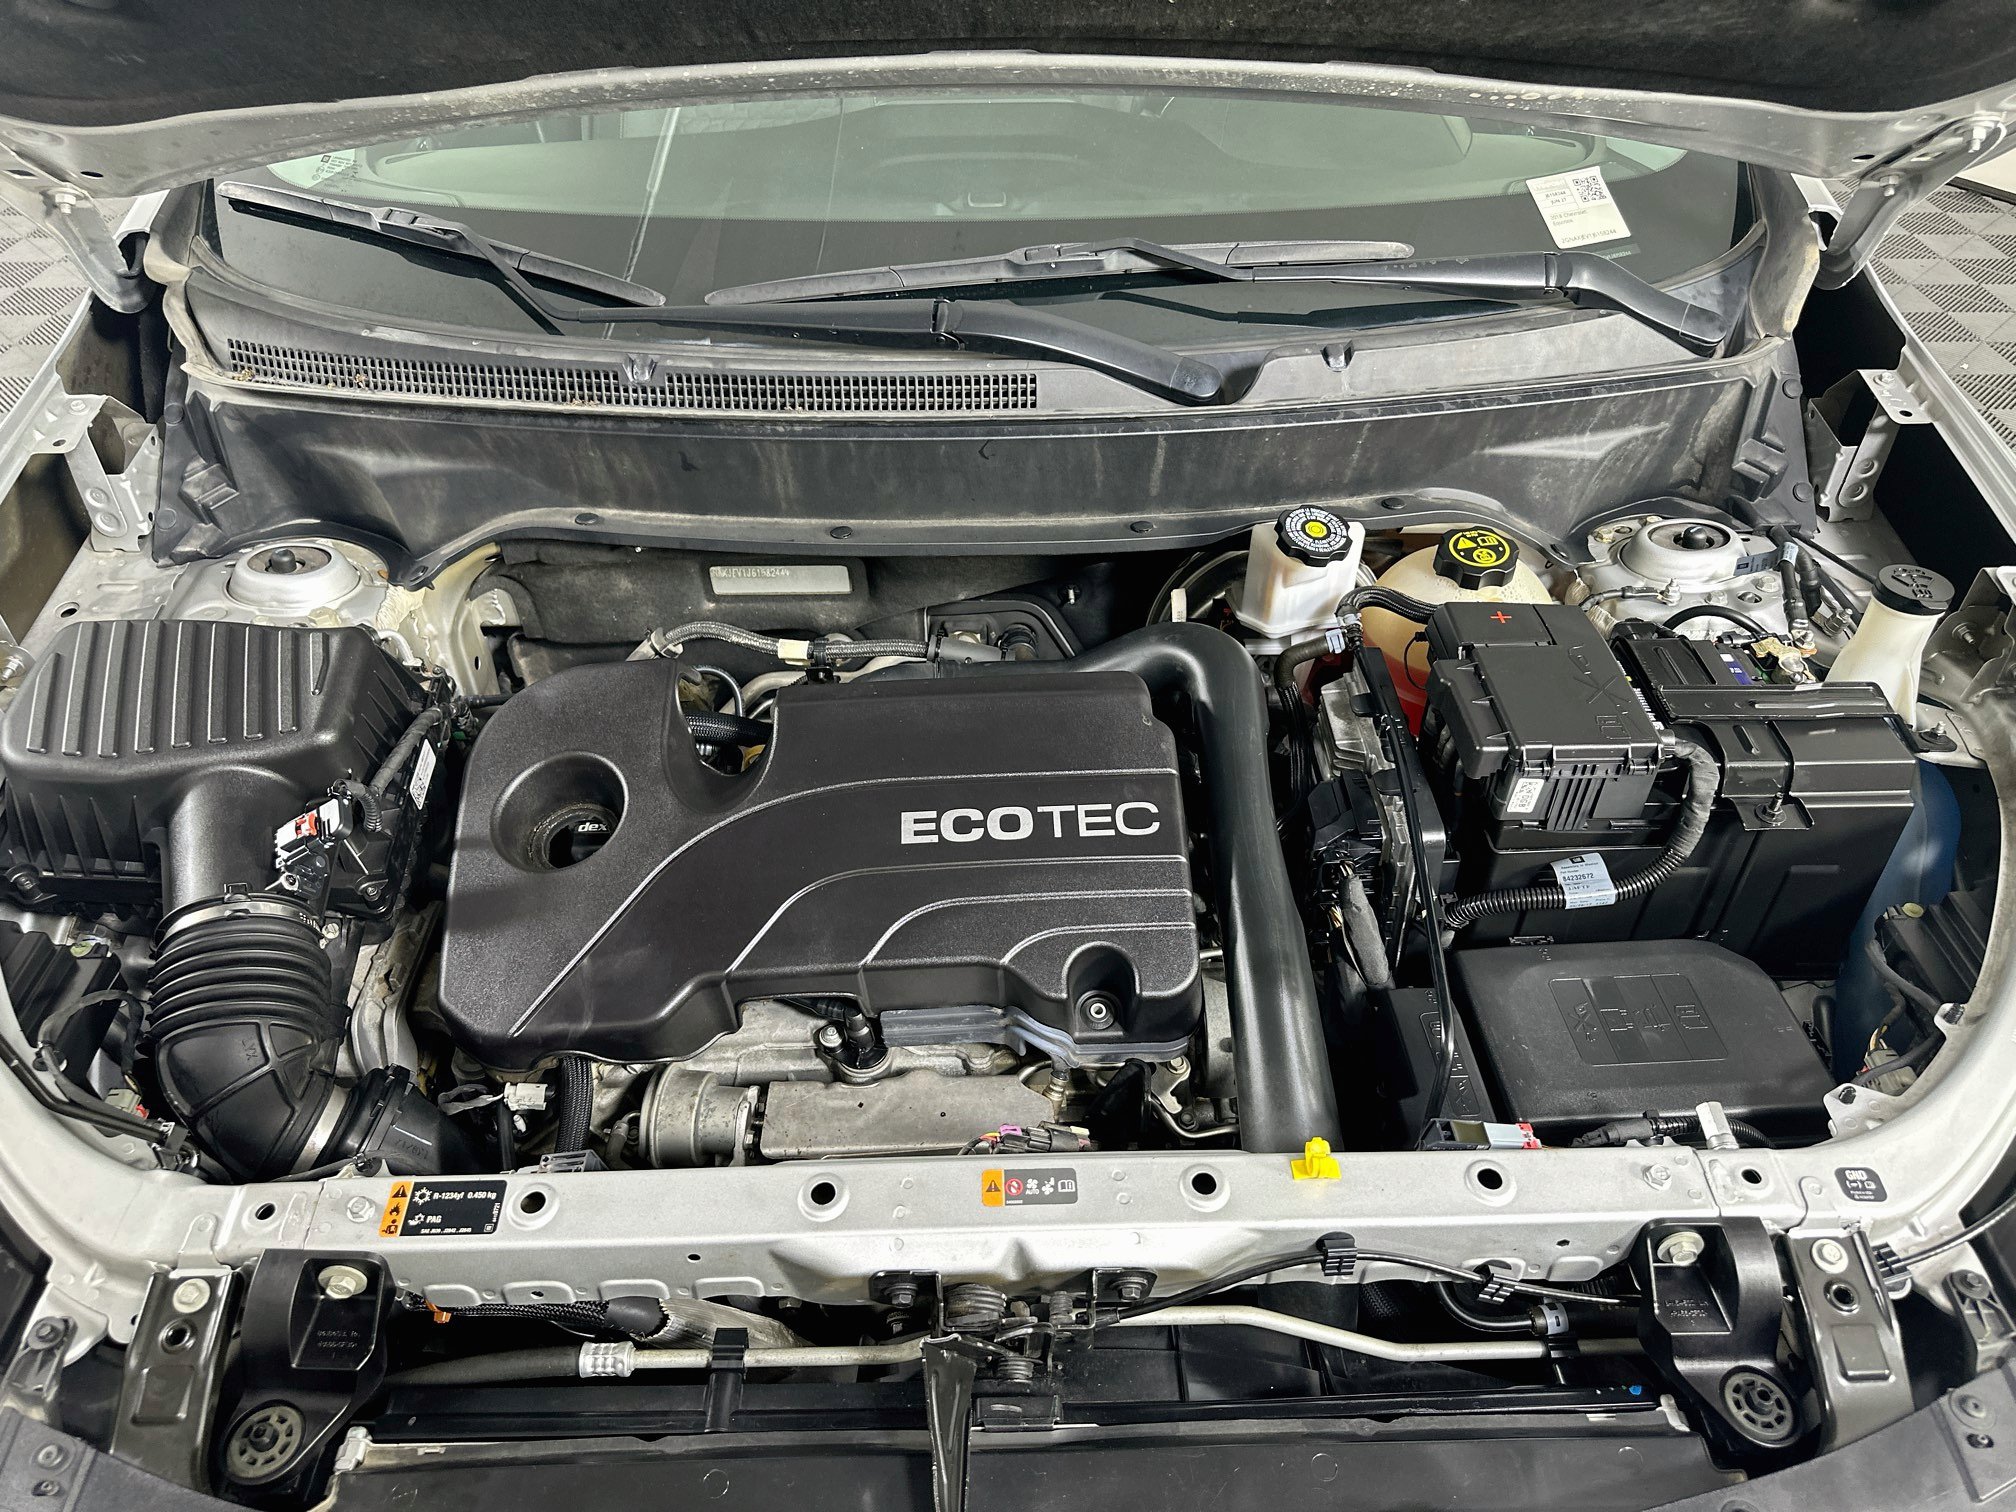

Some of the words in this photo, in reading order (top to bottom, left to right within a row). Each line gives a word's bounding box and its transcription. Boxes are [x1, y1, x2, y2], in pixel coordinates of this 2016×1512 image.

[578, 822, 607, 832] dex
[901, 802, 1160, 844] ECOTEC
[1845, 1170, 1867, 1180] GND
[433, 1191, 465, 1200] R-1234yf
[467, 1191, 487, 1199] 0.450
[487, 1191, 497, 1200] kg
